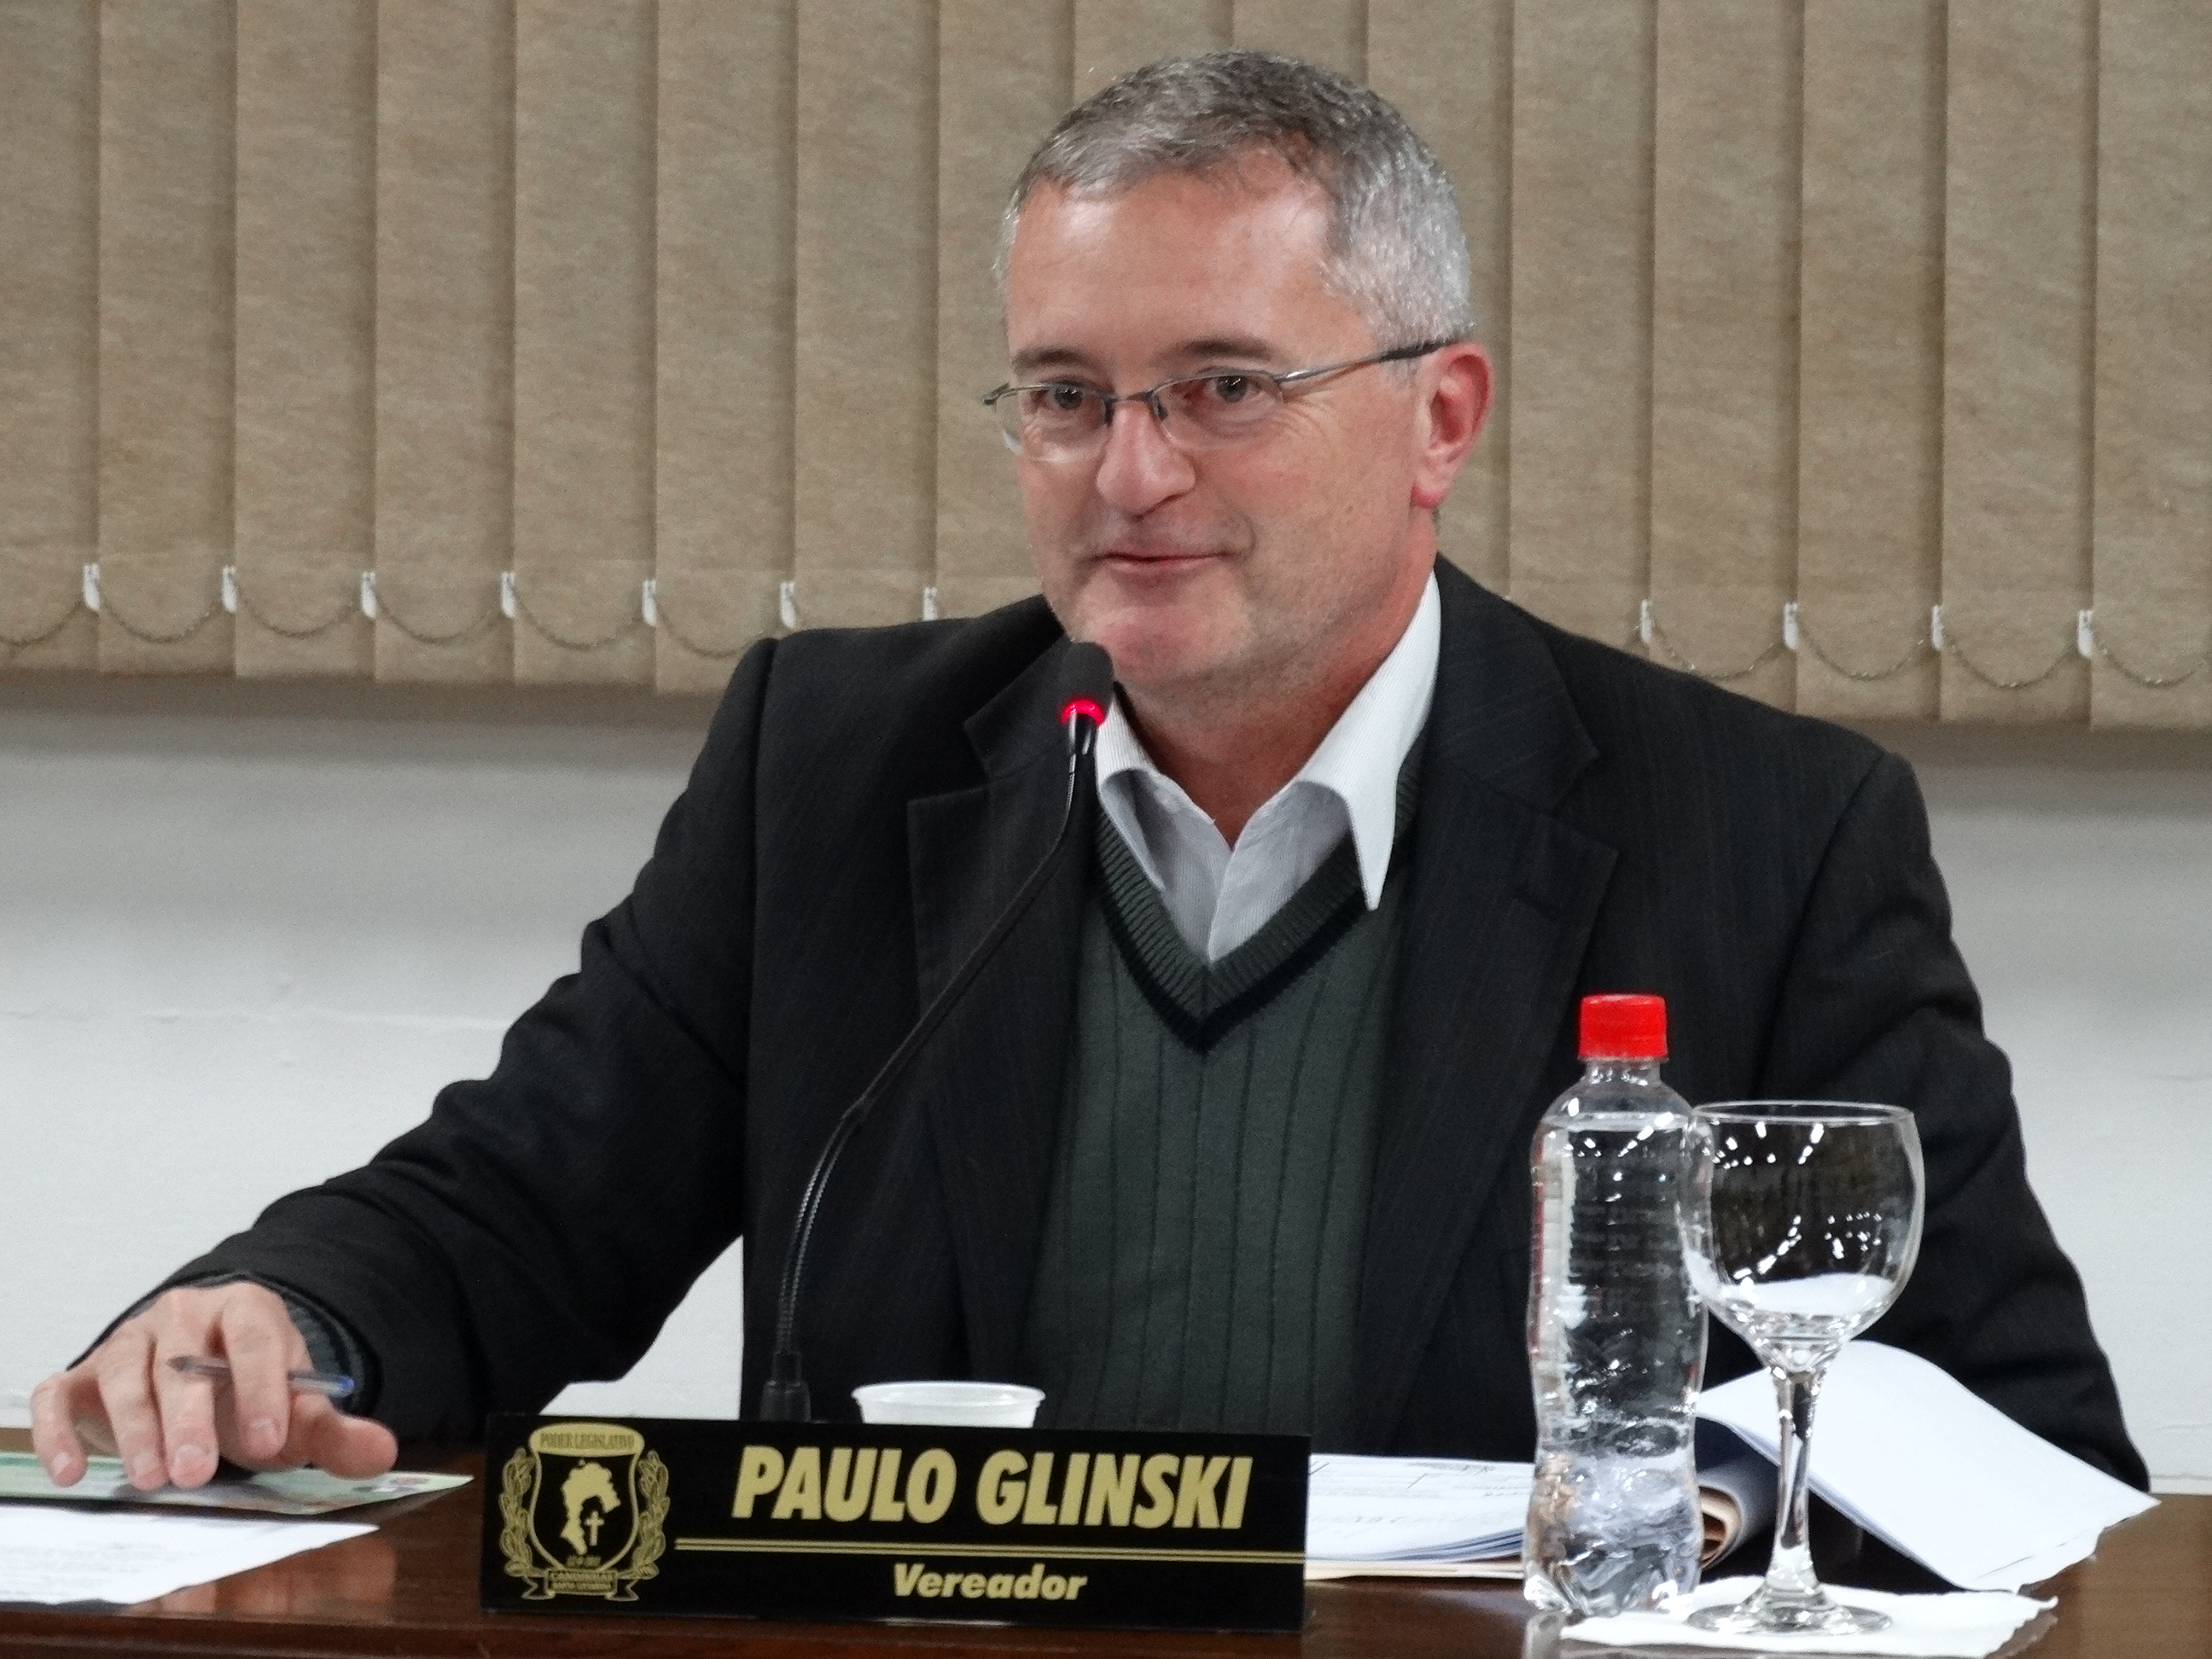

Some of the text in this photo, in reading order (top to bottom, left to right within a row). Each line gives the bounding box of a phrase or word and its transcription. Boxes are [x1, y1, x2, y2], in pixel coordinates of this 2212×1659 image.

[731, 1446, 957, 1524] PAULO
[976, 1450, 1253, 1529] GLINSKI
[894, 1563, 1088, 1600] Vereador
